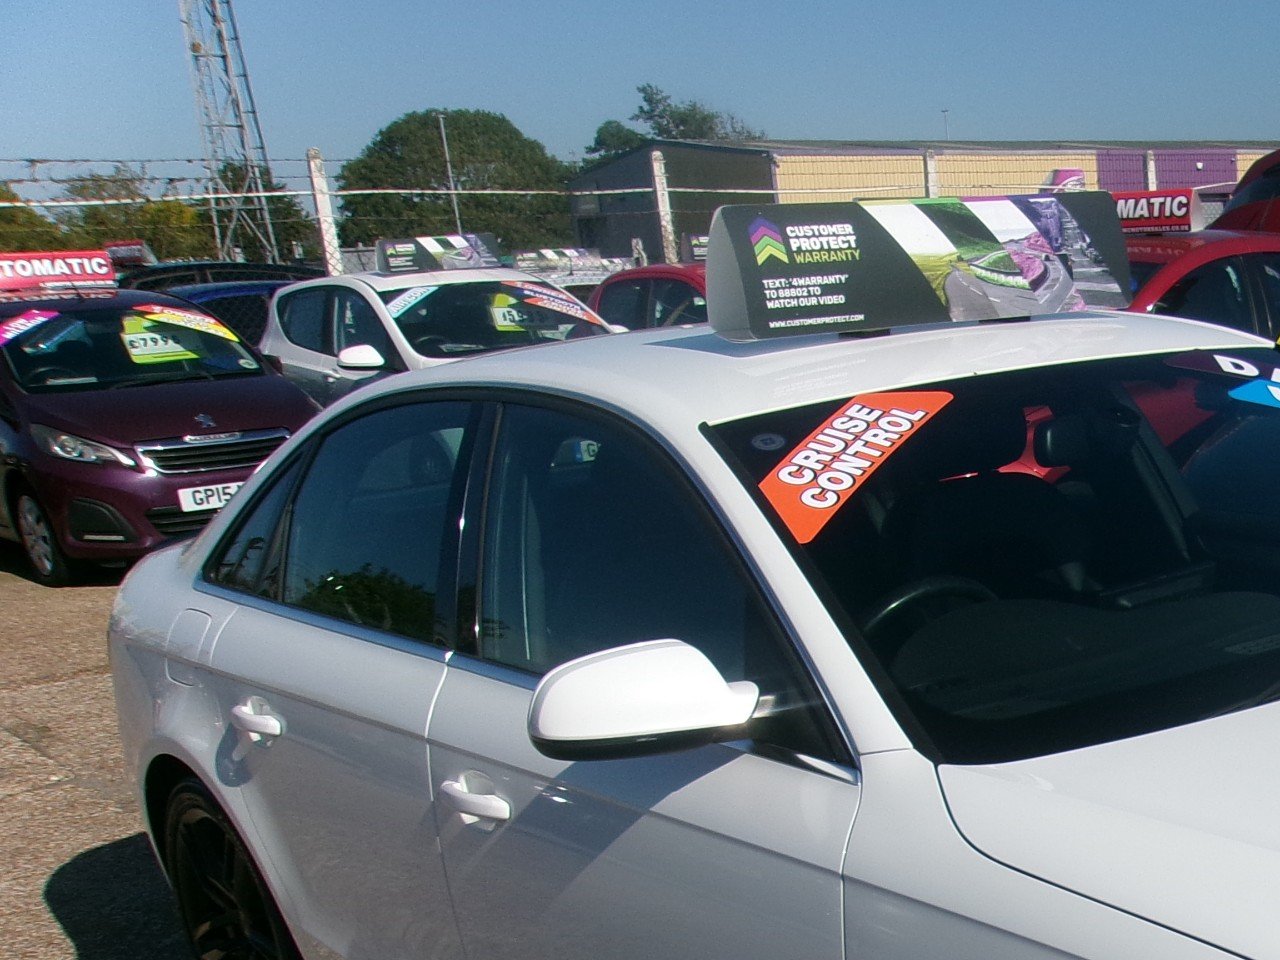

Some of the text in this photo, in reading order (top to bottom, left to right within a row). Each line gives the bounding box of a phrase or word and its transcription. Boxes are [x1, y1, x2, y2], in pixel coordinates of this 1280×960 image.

[1117, 195, 1188, 219] MATIC
[785, 224, 855, 237] CUSTOMER
[789, 235, 857, 251] PROTECT
[793, 249, 861, 264] WARRANTY
[762, 278, 789, 289] TEXT:
[764, 289, 777, 299] TO
[810, 286, 821, 296] TO
[766, 294, 845, 309] WATCH OUR VIDEO
[769, 314, 865, 329] WWW.CUSTOMERPROTECT.COM
[776, 403, 885, 486] CRUISE
[800, 407, 928, 510] CONTROL
